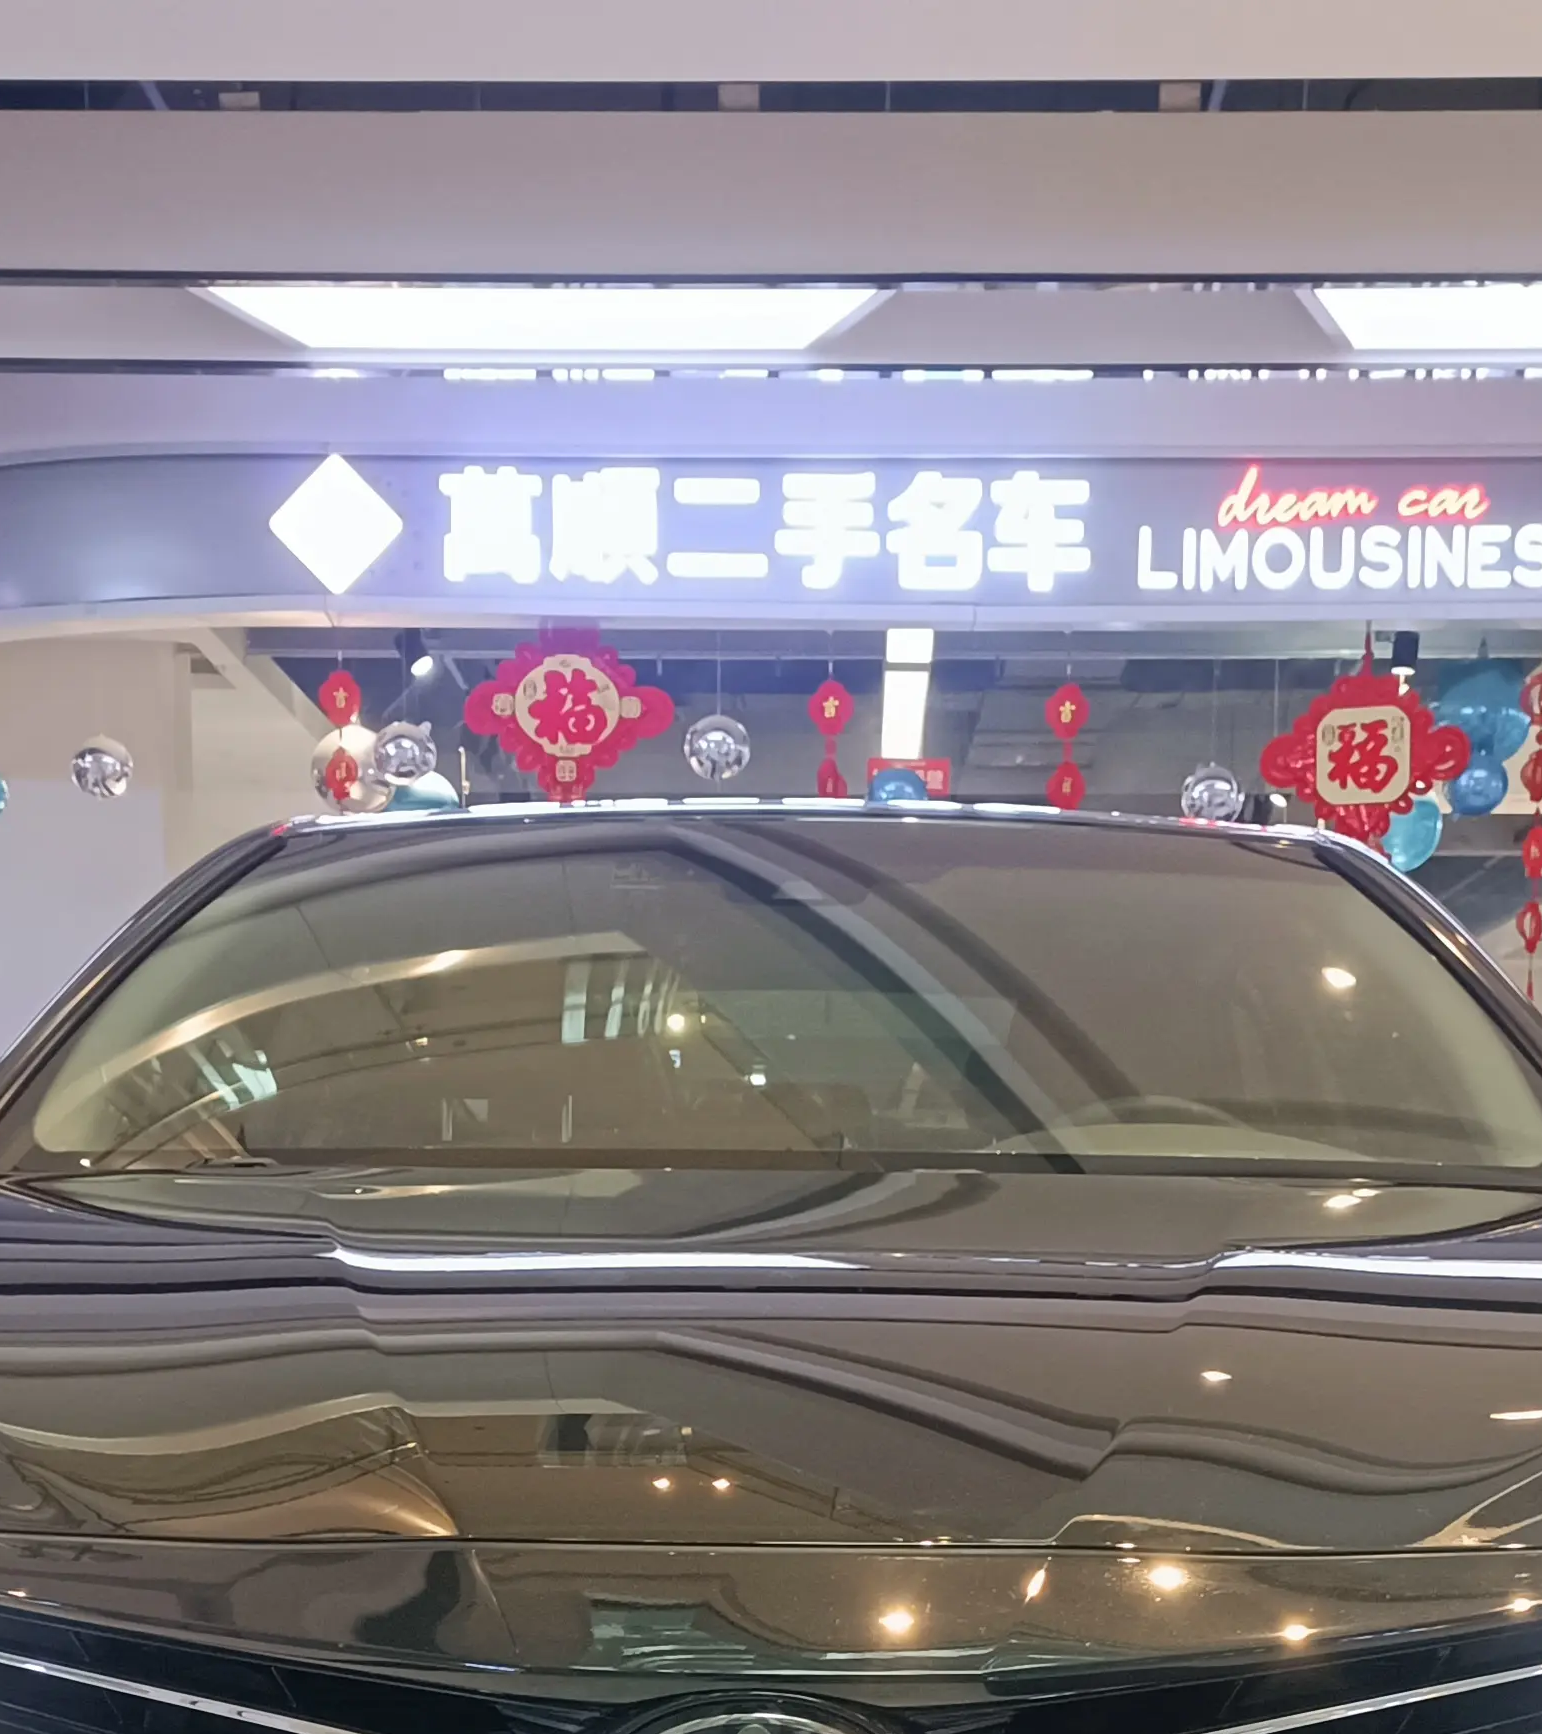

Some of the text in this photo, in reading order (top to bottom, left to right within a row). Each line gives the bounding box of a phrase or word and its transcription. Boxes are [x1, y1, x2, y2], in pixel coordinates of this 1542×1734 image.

[438, 465, 1092, 592] 萬順二手名车
[1216, 463, 1489, 527] dream car
[527, 668, 609, 745] 福
[1327, 718, 1399, 794] 福
